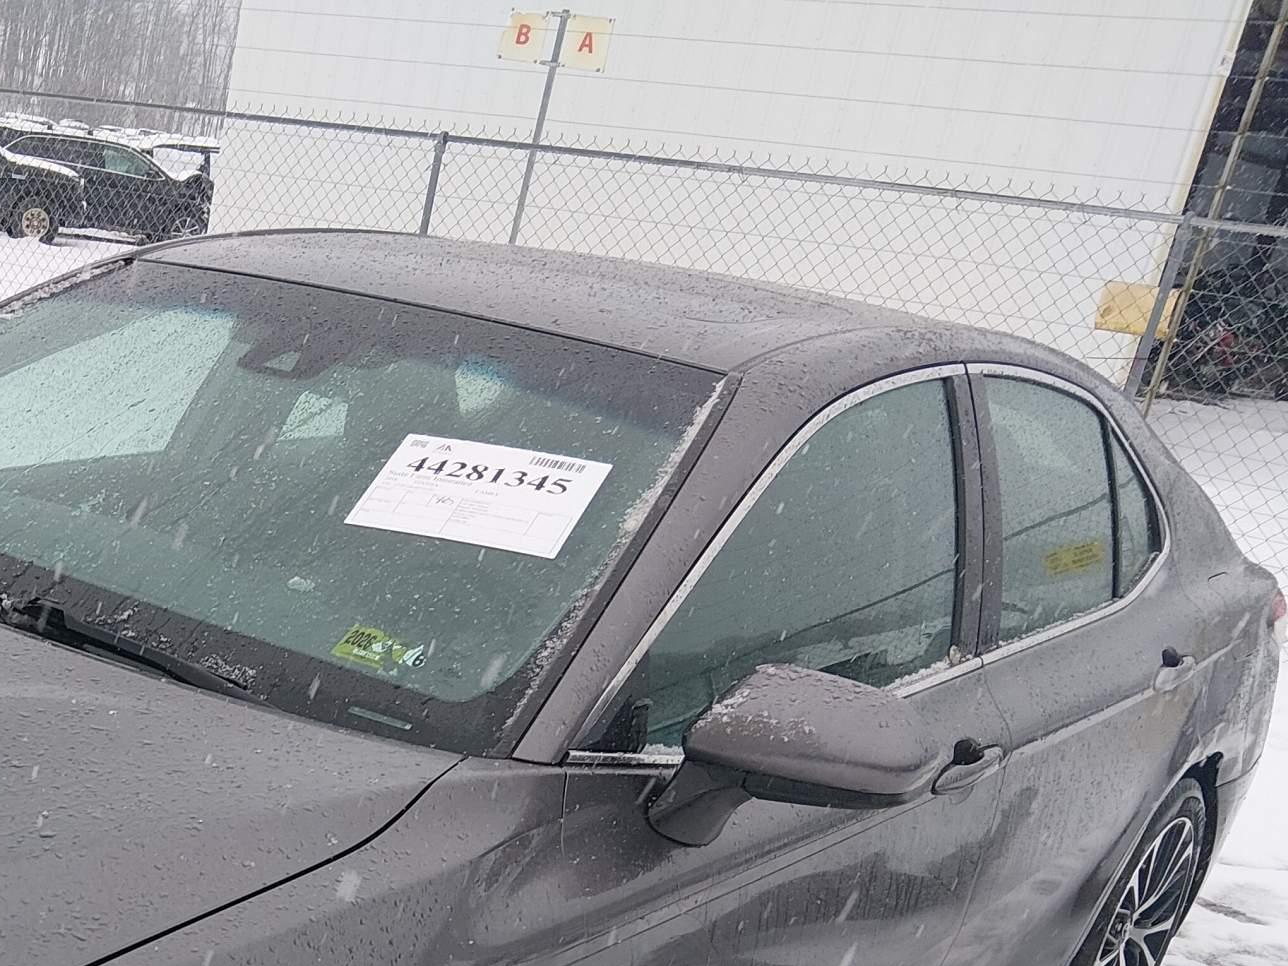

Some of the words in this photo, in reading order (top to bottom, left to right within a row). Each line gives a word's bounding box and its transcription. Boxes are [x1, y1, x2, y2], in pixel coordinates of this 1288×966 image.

[515, 23, 531, 45] B
[577, 31, 594, 54] A
[407, 456, 572, 495] 44281345
[344, 629, 378, 650] 2026
